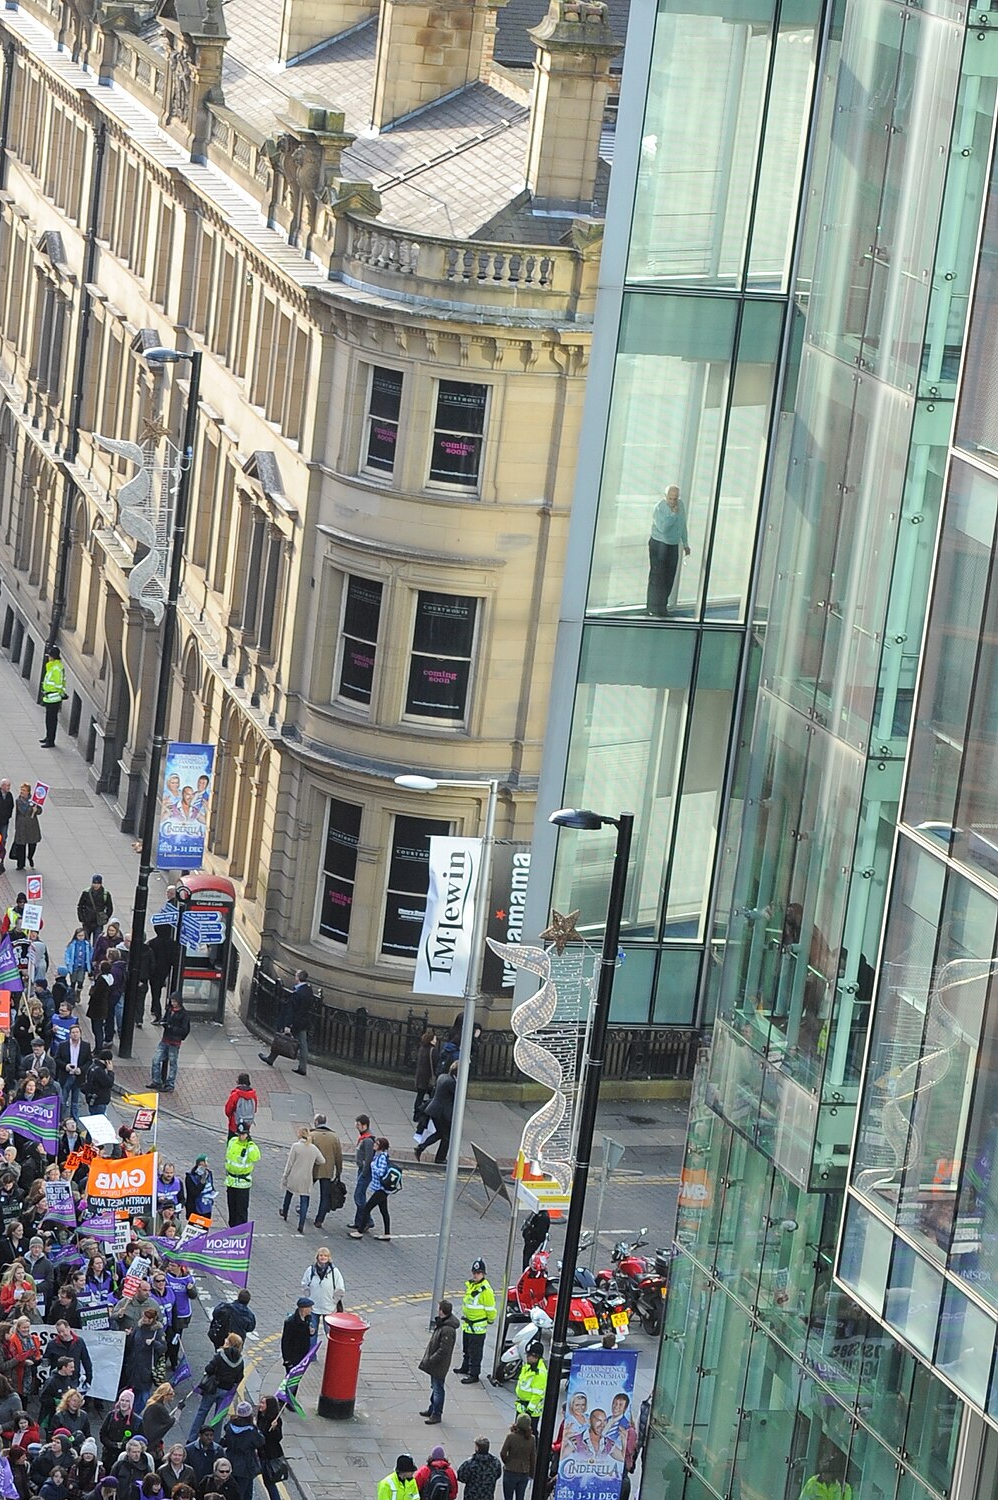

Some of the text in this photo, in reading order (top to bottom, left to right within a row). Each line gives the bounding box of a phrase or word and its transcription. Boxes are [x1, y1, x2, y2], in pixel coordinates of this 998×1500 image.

[190, 845, 203, 853] DEC
[502, 853, 532, 988] waamama
[559, 1458, 621, 1481] CINDERELLA
[577, 1492, 596, 1500] 3-31
